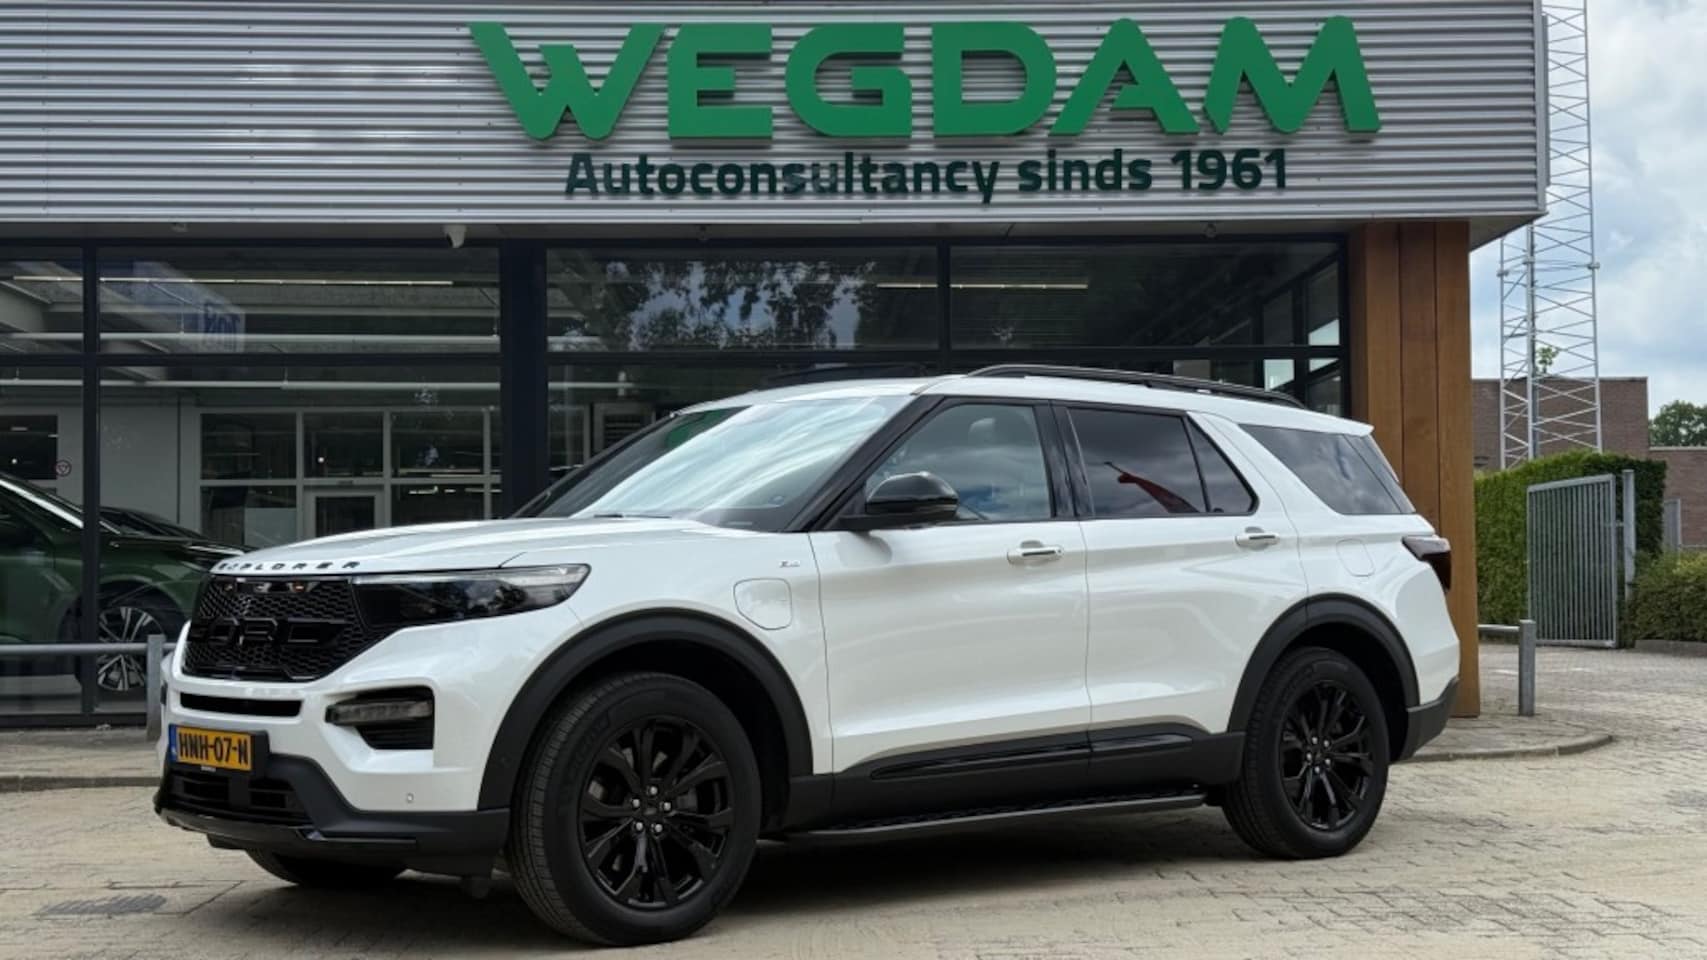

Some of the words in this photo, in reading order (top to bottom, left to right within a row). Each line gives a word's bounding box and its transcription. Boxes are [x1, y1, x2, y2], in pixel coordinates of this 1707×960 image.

[468, 15, 1381, 141] WEGDAM
[565, 152, 1000, 205] Autoconsultancy
[1017, 149, 1152, 192] sinds
[1171, 149, 1287, 191] 1961
